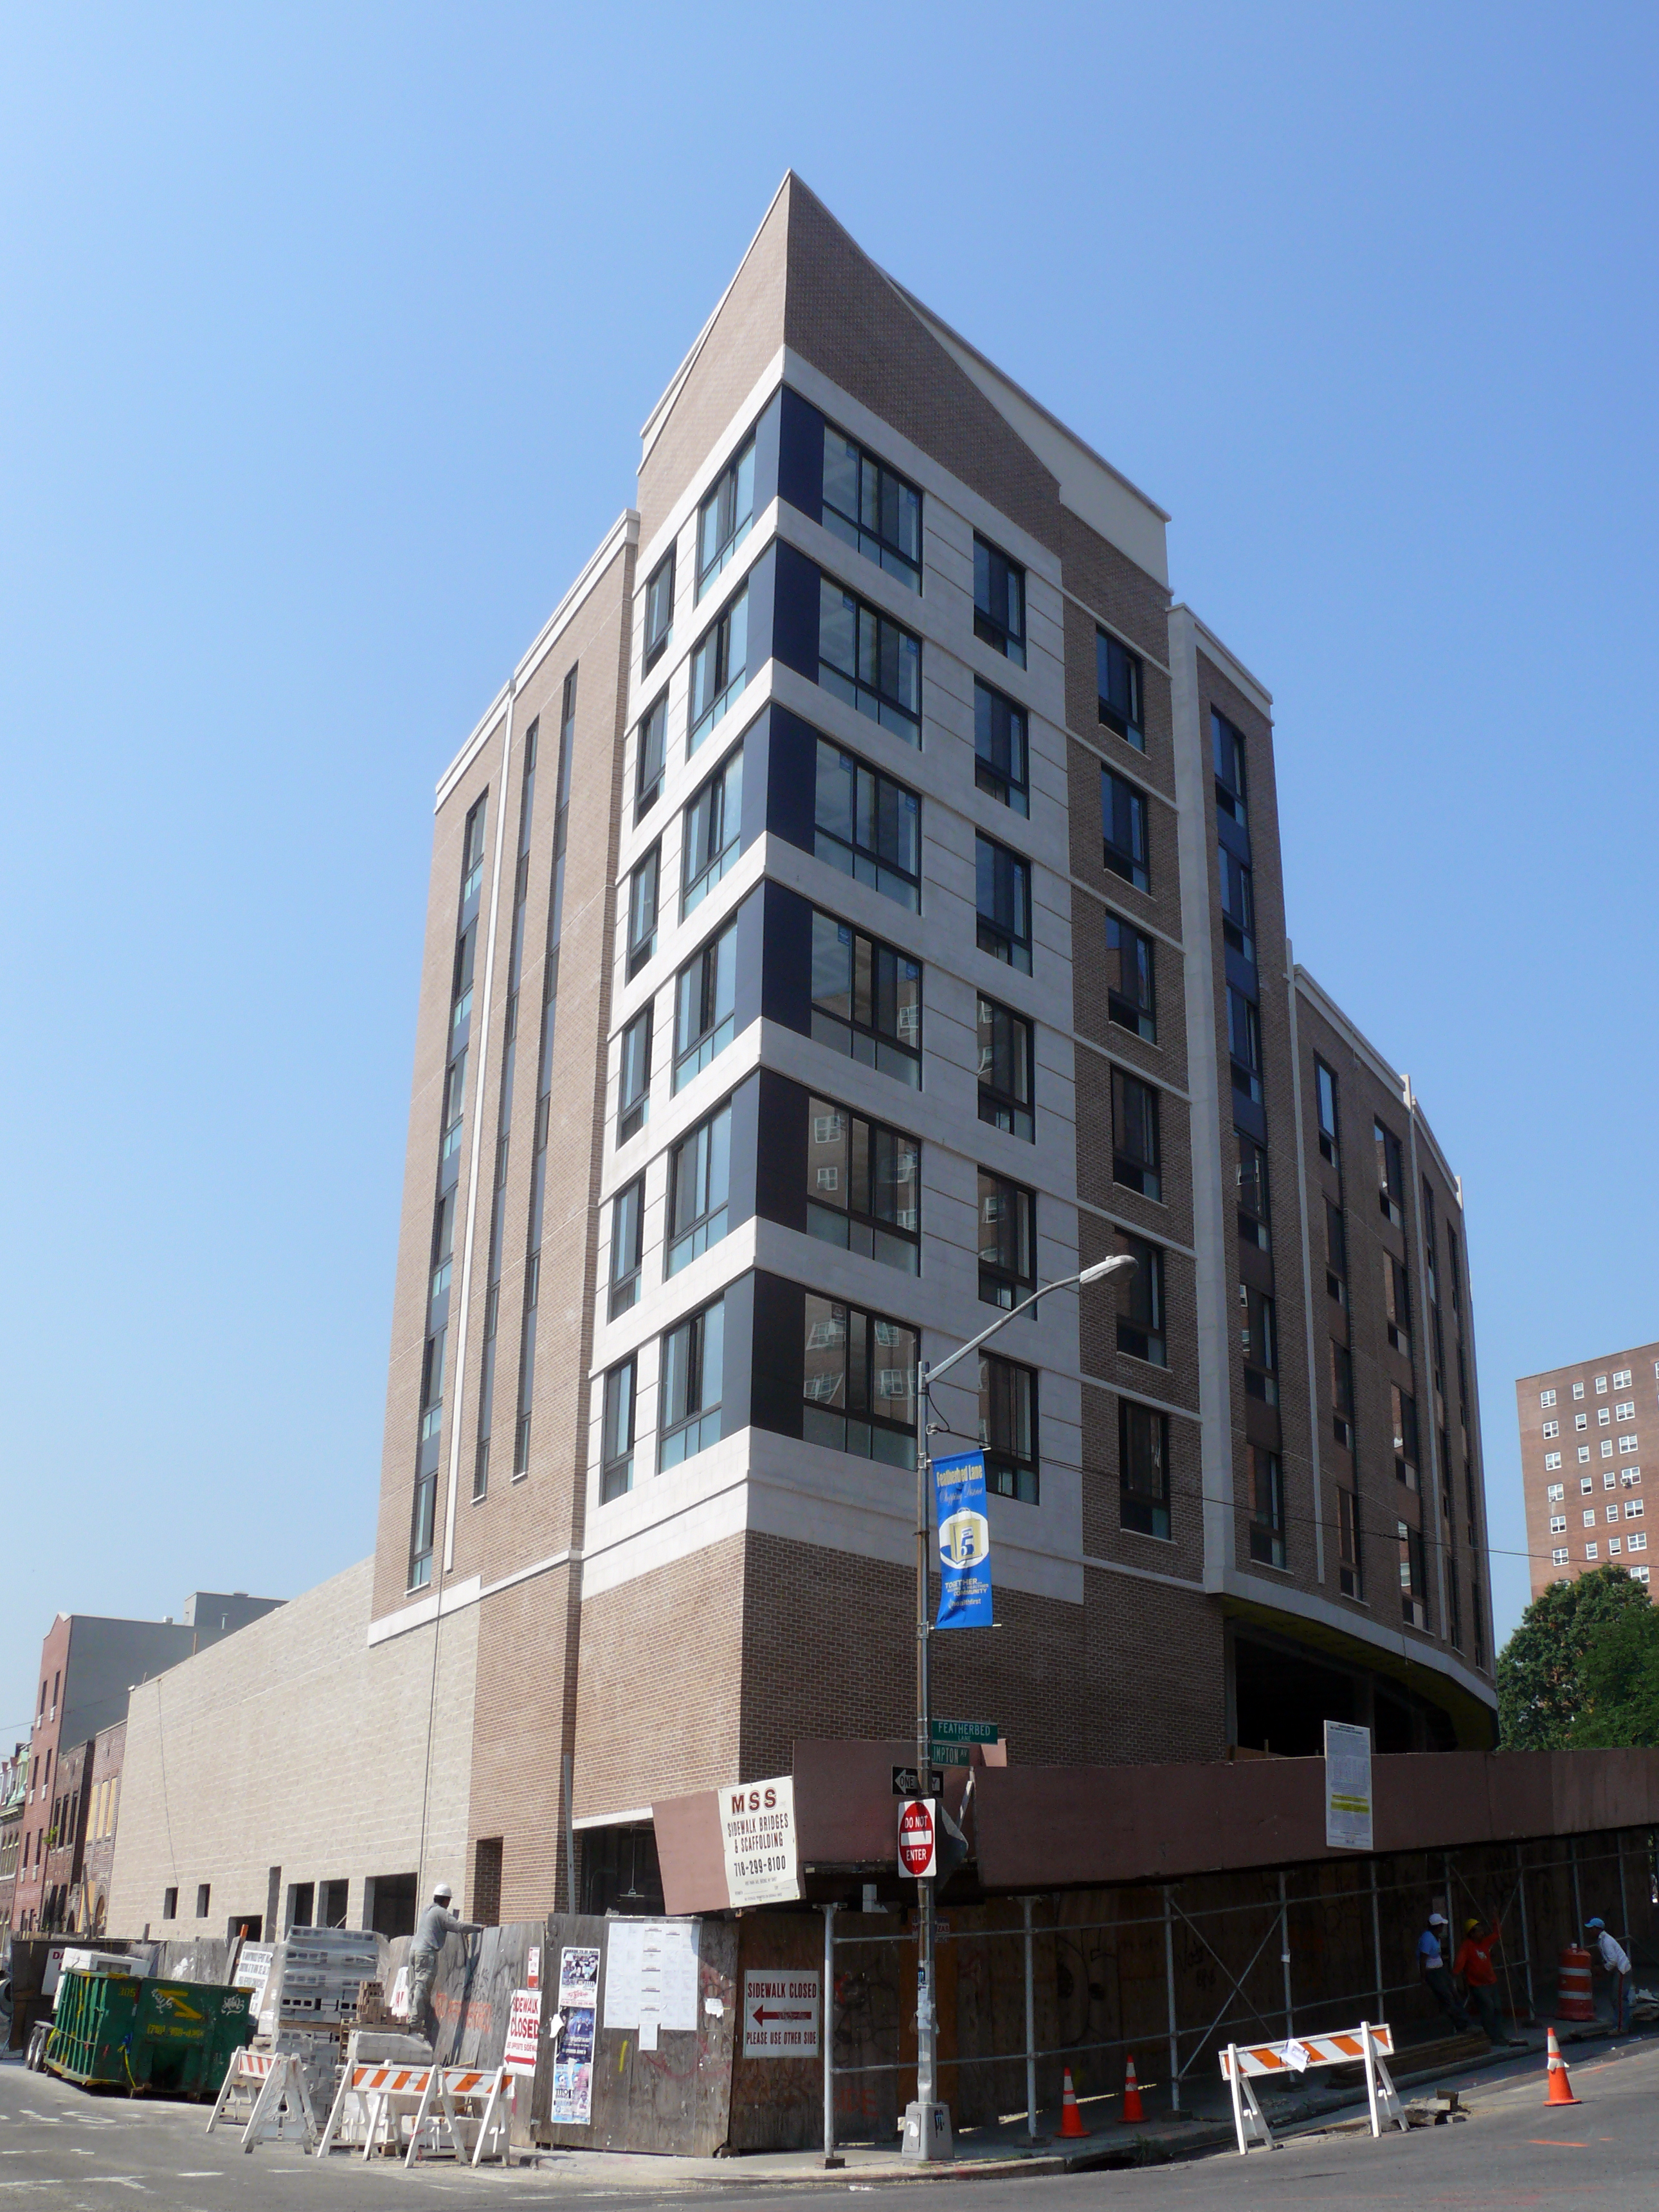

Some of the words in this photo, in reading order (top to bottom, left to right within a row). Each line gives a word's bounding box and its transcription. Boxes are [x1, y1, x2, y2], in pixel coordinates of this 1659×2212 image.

[936, 1465, 968, 1487] Featherbed
[968, 1464, 983, 1481] Lane
[954, 1588, 987, 1596] COMMUNITY
[939, 1722, 990, 1736] FEATHERBED
[934, 1746, 959, 1764] IMPTON
[900, 1776, 914, 1788] ONE
[731, 1787, 777, 1816] MSS
[727, 1818, 756, 1838] SIDEWALK
[759, 1813, 788, 1832] BRIDGES
[905, 1817, 913, 1829] DO
[915, 1815, 928, 1828] NOT
[741, 1831, 783, 1853] SCAFFOLDING
[906, 1848, 927, 1861] ENTER
[734, 1855, 786, 1876] 718-299-8100
[748, 1982, 786, 1998] SIDEWALK
[790, 1982, 817, 1998] CLOSED
[512, 1997, 538, 2014] SIDEWALK
[511, 2017, 539, 2039] CLOSED
[747, 2031, 767, 2045] PLEASE
[770, 2031, 781, 2045] USE
[784, 2031, 801, 2045] OTHER
[804, 2031, 816, 2045] SIDE
